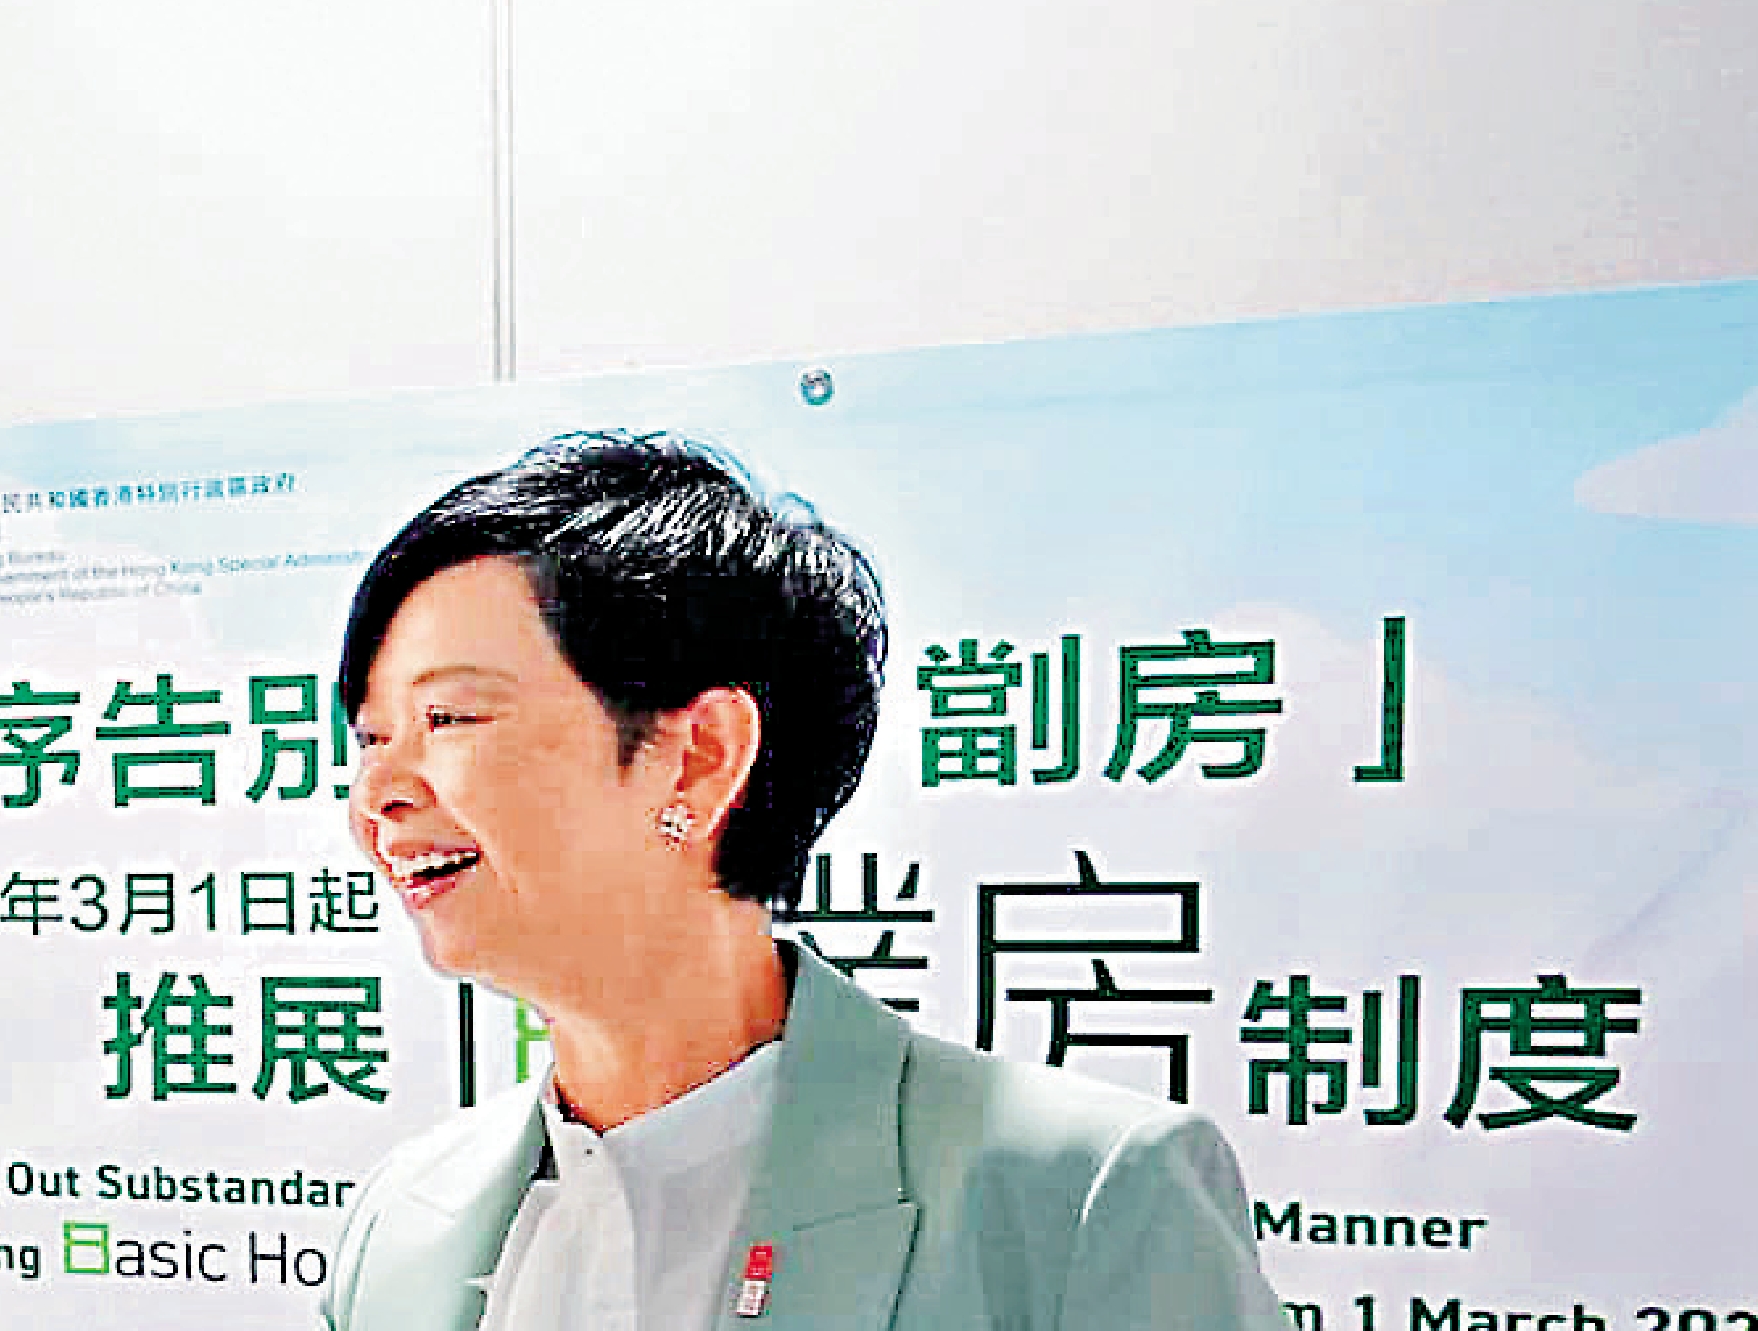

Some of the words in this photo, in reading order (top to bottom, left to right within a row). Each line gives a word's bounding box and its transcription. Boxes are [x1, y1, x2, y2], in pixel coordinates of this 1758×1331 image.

[9, 1162, 81, 1196] Out
[96, 1165, 357, 1208] Substandar
[1252, 1201, 1488, 1249] Manner
[63, 1222, 227, 1282] Basic
[248, 1231, 327, 1287] Ho
